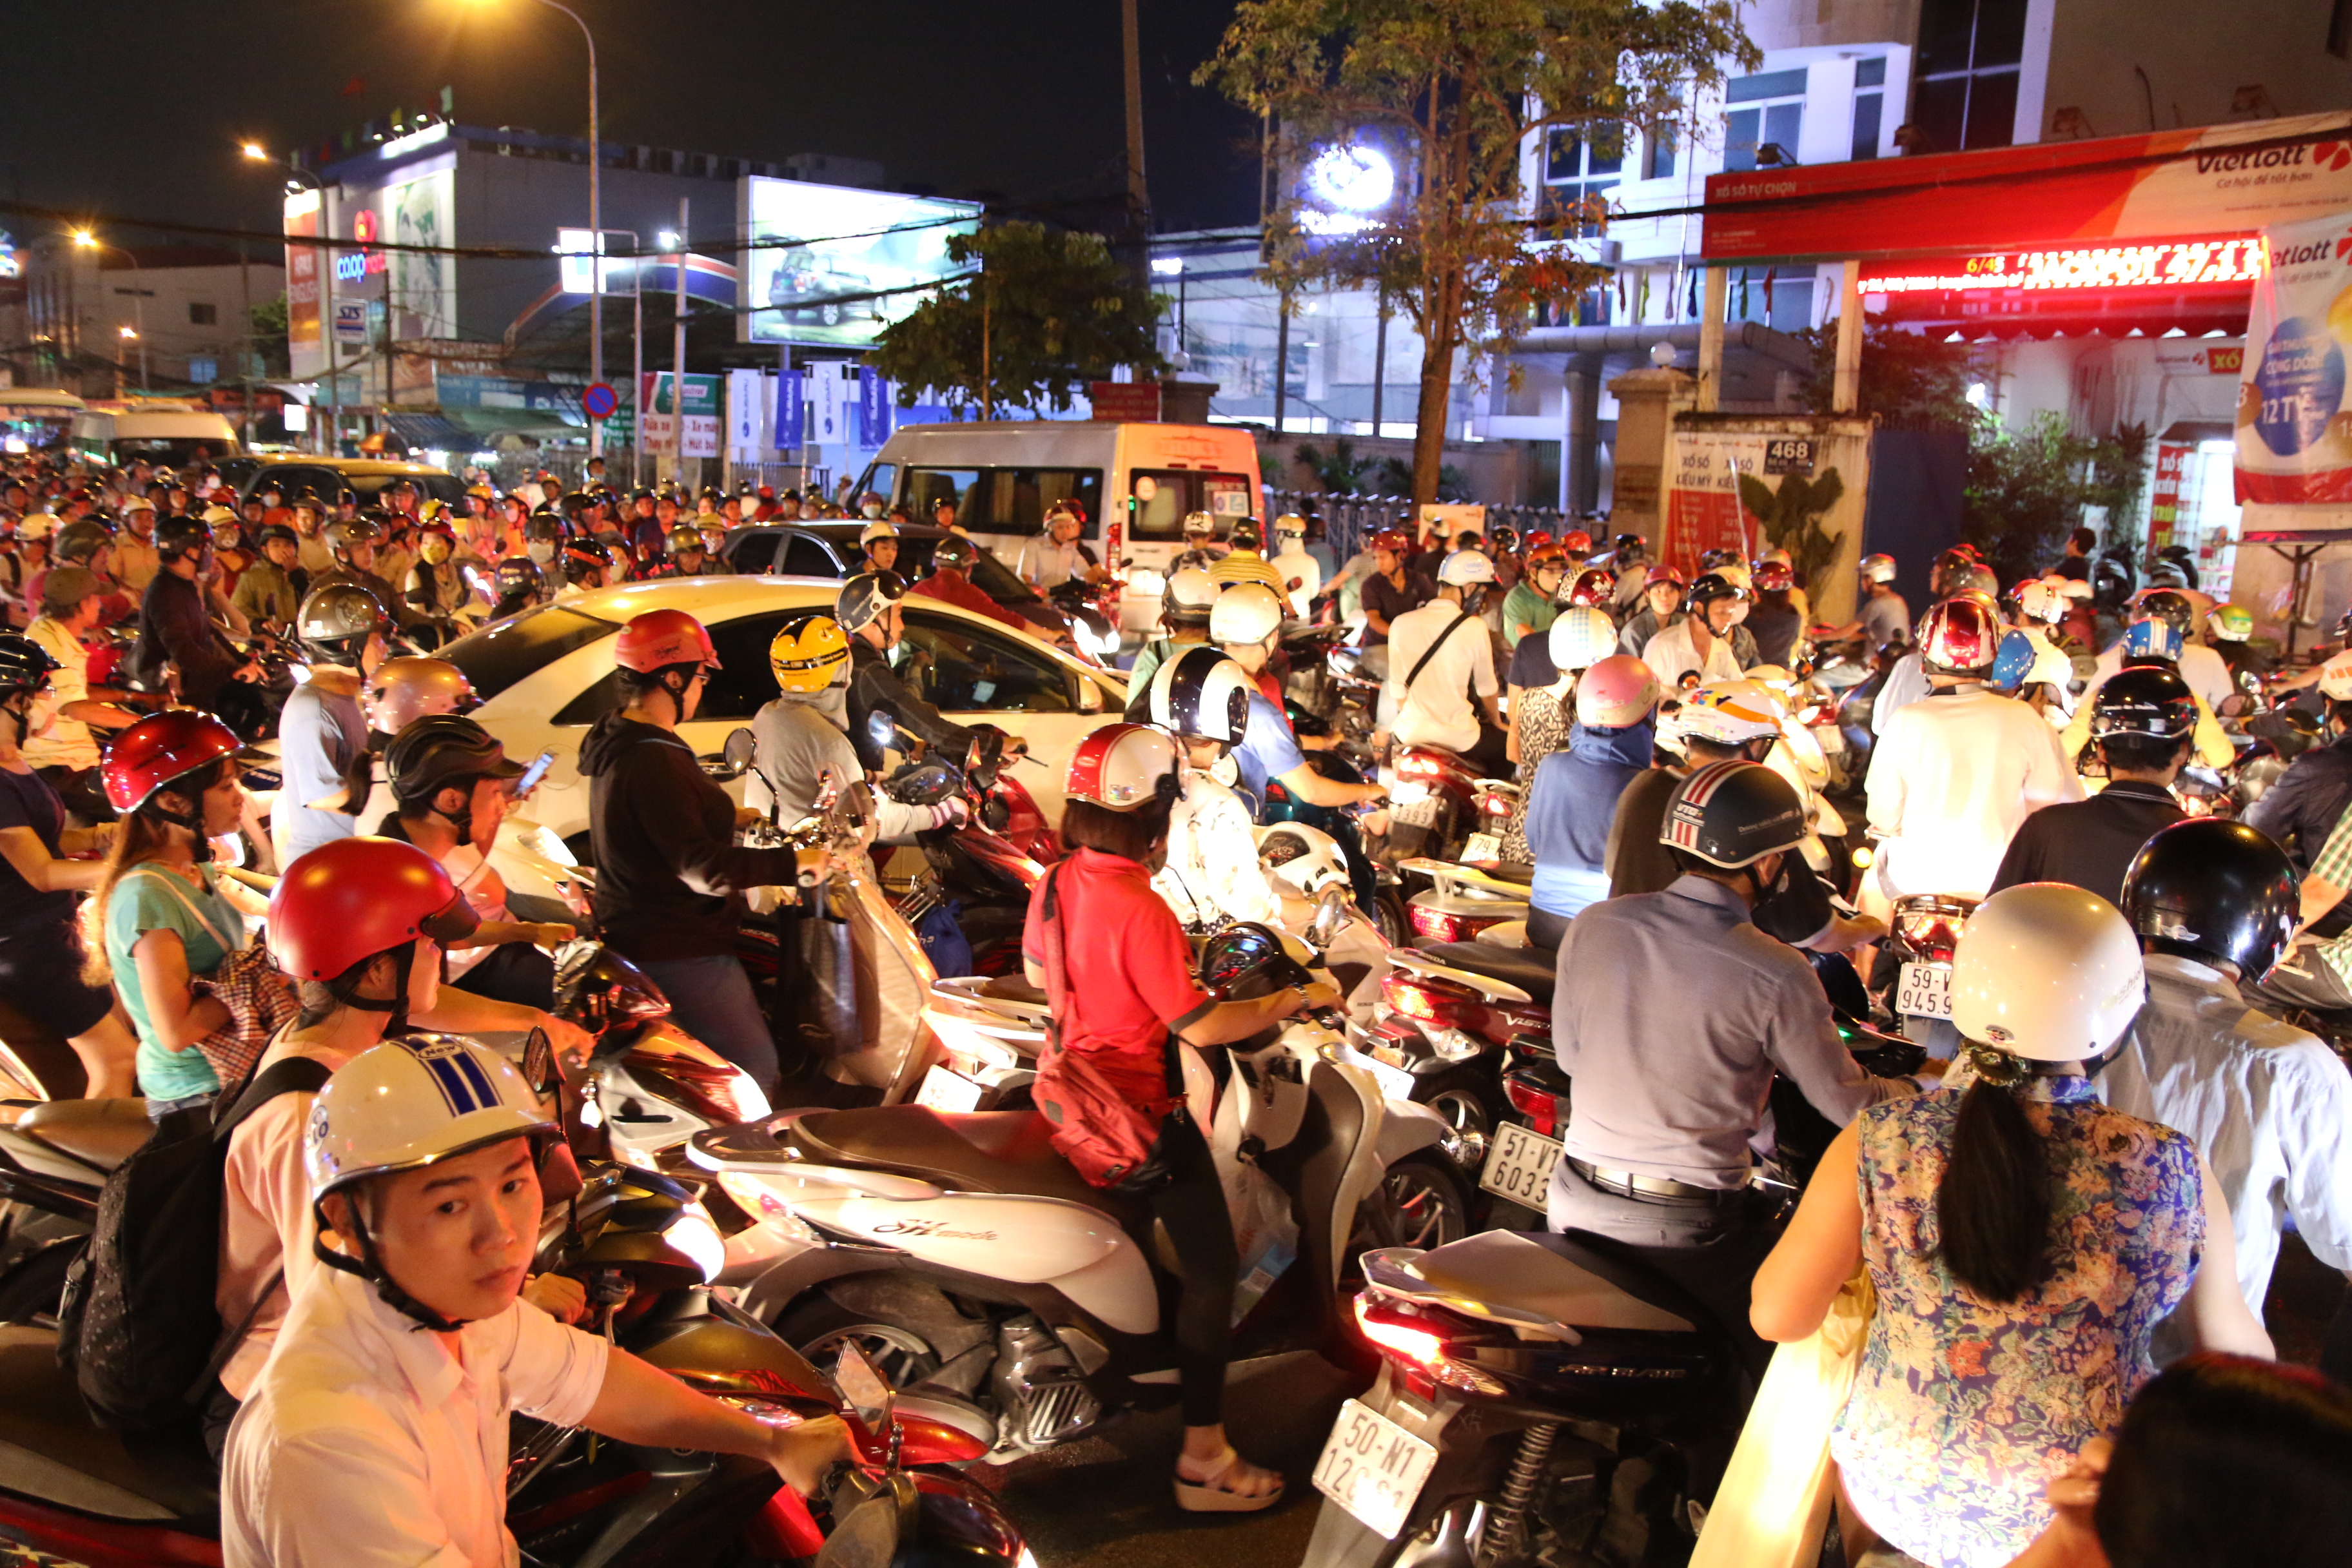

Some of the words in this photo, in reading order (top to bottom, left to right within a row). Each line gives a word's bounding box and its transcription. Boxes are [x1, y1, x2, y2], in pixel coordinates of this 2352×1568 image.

[1912, 968, 1952, 992] 59-V
[1901, 990, 1952, 1015] 945.9
[425, 1044, 456, 1056] New
[1344, 1412, 1416, 1478] 50-N1
